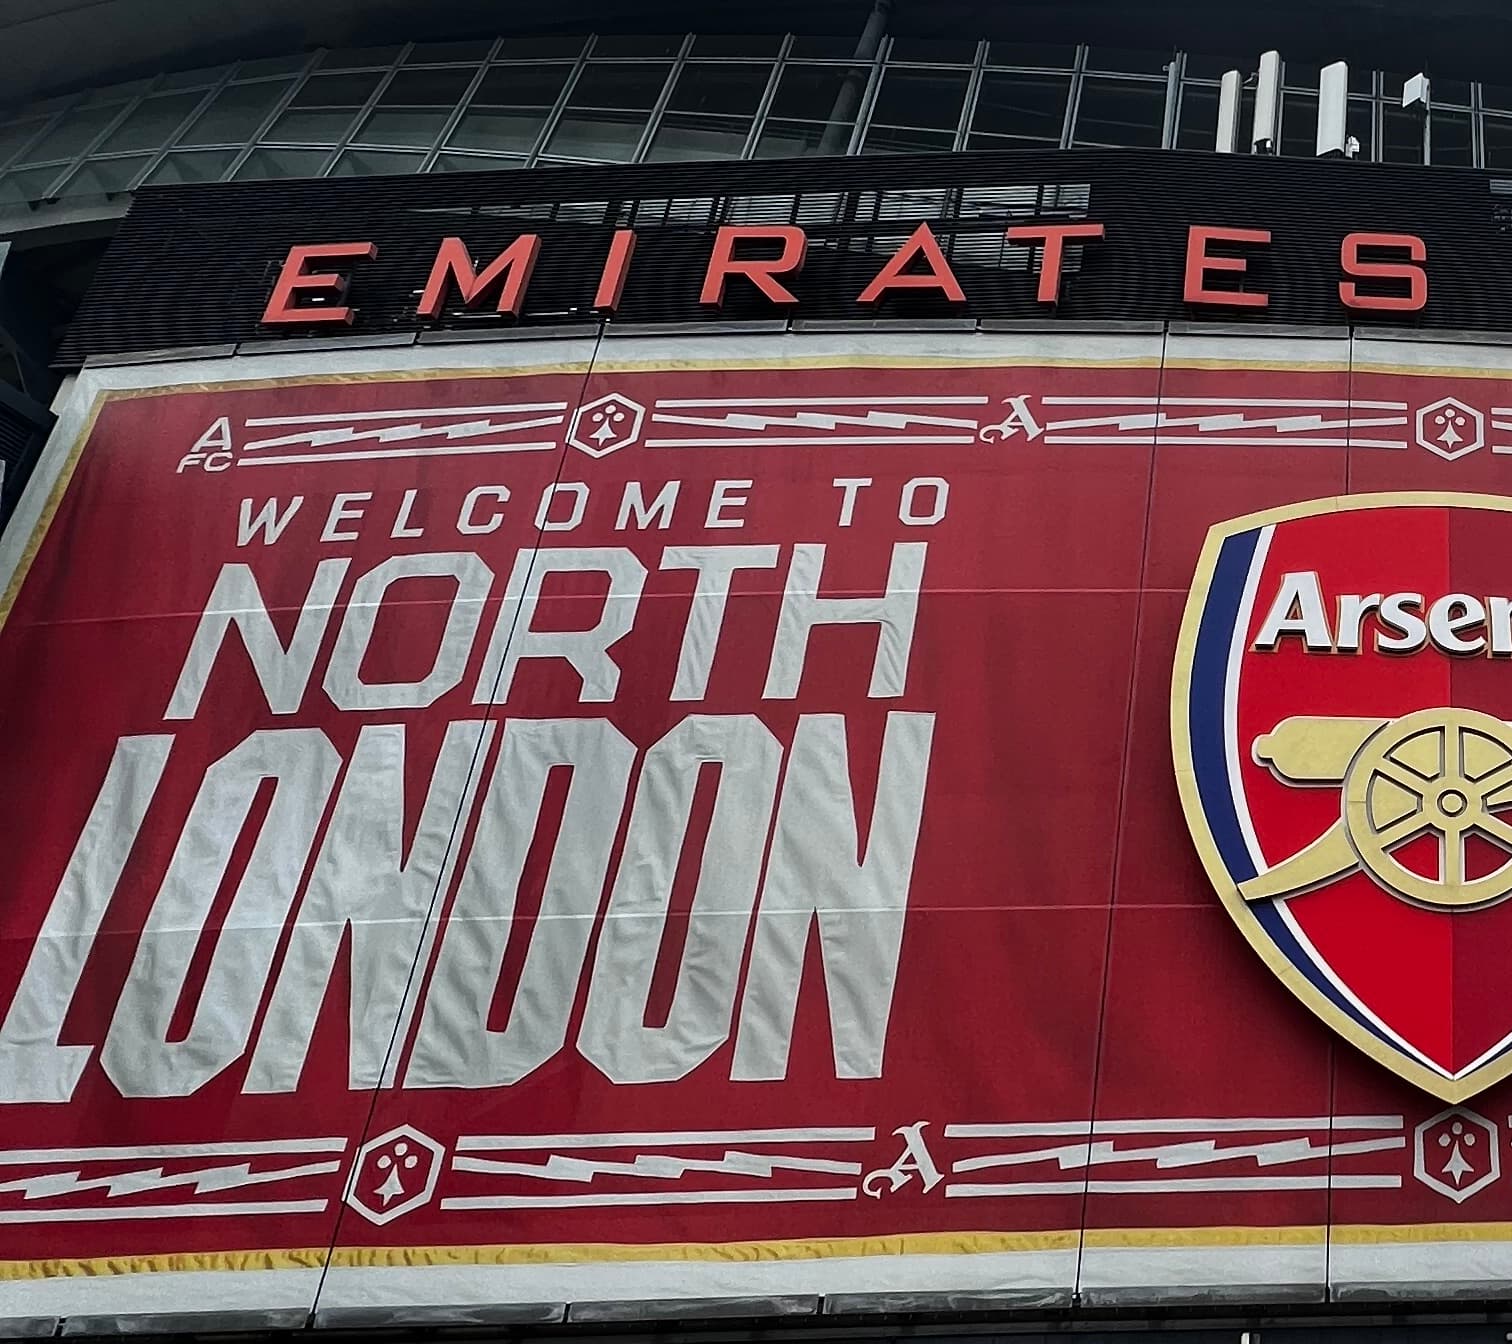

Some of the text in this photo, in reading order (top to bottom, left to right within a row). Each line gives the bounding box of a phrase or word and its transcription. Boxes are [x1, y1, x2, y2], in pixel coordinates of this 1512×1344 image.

[260, 221, 1428, 327] EMIRATES
[235, 476, 952, 547] WELCOME TO
[164, 542, 929, 721] NORTH
[0, 711, 937, 1105] LONDON
